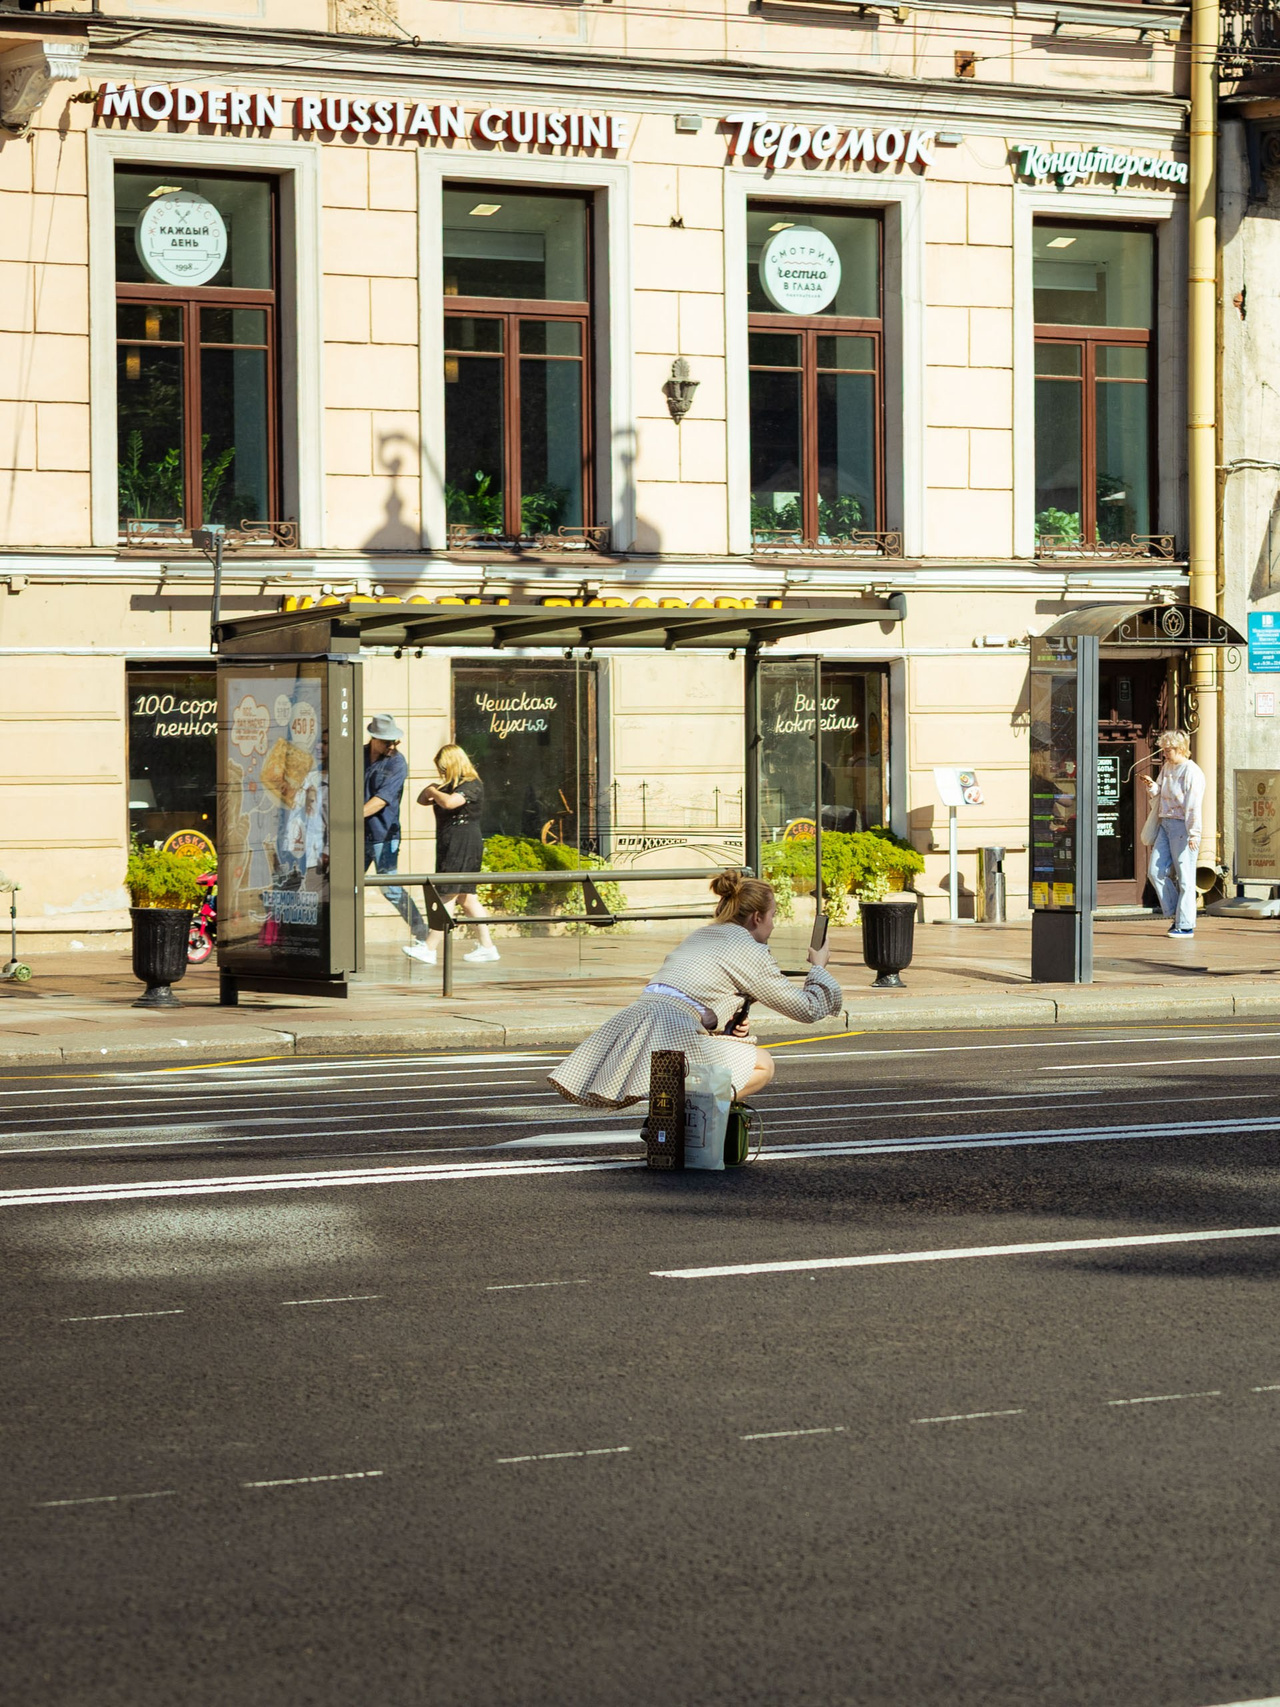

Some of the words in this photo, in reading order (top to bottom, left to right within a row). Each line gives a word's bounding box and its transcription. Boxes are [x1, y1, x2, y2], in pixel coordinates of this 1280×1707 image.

[99, 82, 283, 127] MODERN
[299, 96, 466, 138] RUSSIAN
[475, 108, 629, 149] CUISINE
[722, 111, 938, 169] Теремок
[1015, 144, 1189, 187] Кондитерская
[160, 226, 209, 235] КАЖДЫЙ
[171, 239, 199, 247] ДЕНЬ
[771, 246, 834, 266] СМОТРИМ
[778, 267, 828, 279] честно
[784, 282, 789, 290] В
[793, 282, 822, 291] ГЛАЗА
[134, 695, 175, 715] 100
[476, 692, 557, 711] Чешская
[292, 718, 307, 735] 450
[490, 713, 547, 739] кухня
